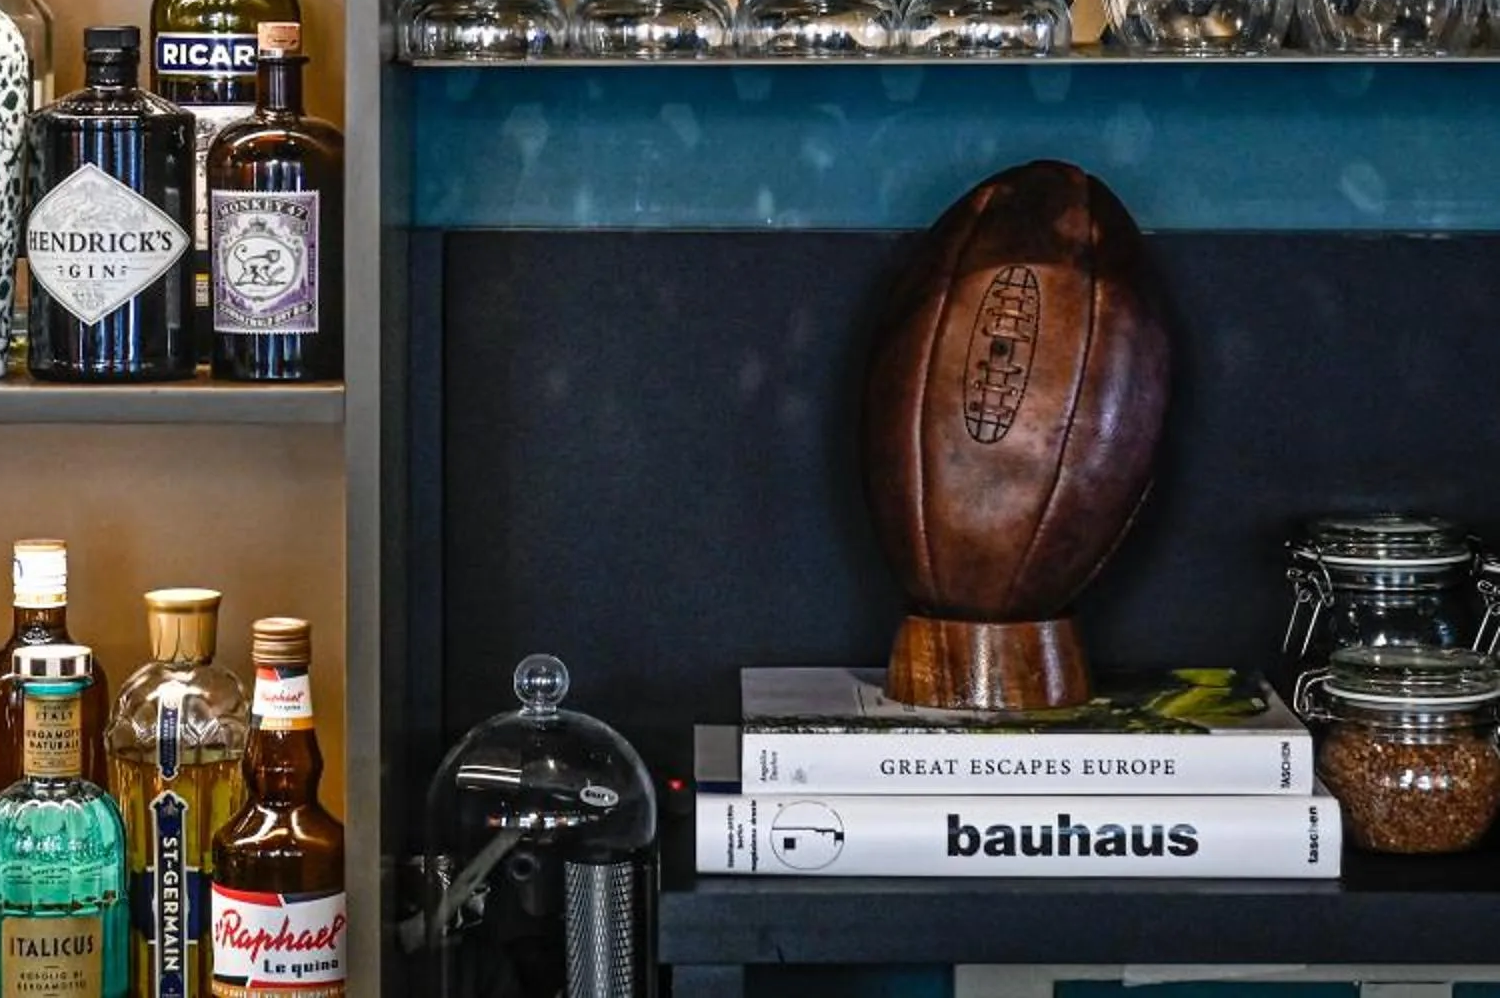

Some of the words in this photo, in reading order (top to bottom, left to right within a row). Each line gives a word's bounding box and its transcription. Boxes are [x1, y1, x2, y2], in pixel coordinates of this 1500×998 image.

[162, 43, 255, 66] RICAR
[29, 230, 173, 253] HENDRICK'S
[68, 264, 116, 279] GIN
[879, 758, 961, 776] GREAT
[970, 758, 1071, 776] ESCAPES
[1083, 758, 1177, 776] EUROPE
[946, 813, 1199, 858] bauhaus
[162, 836, 180, 972] ST-GERMAIN
[8, 935, 94, 957] ITALICUS
[263, 959, 286, 974] Le
